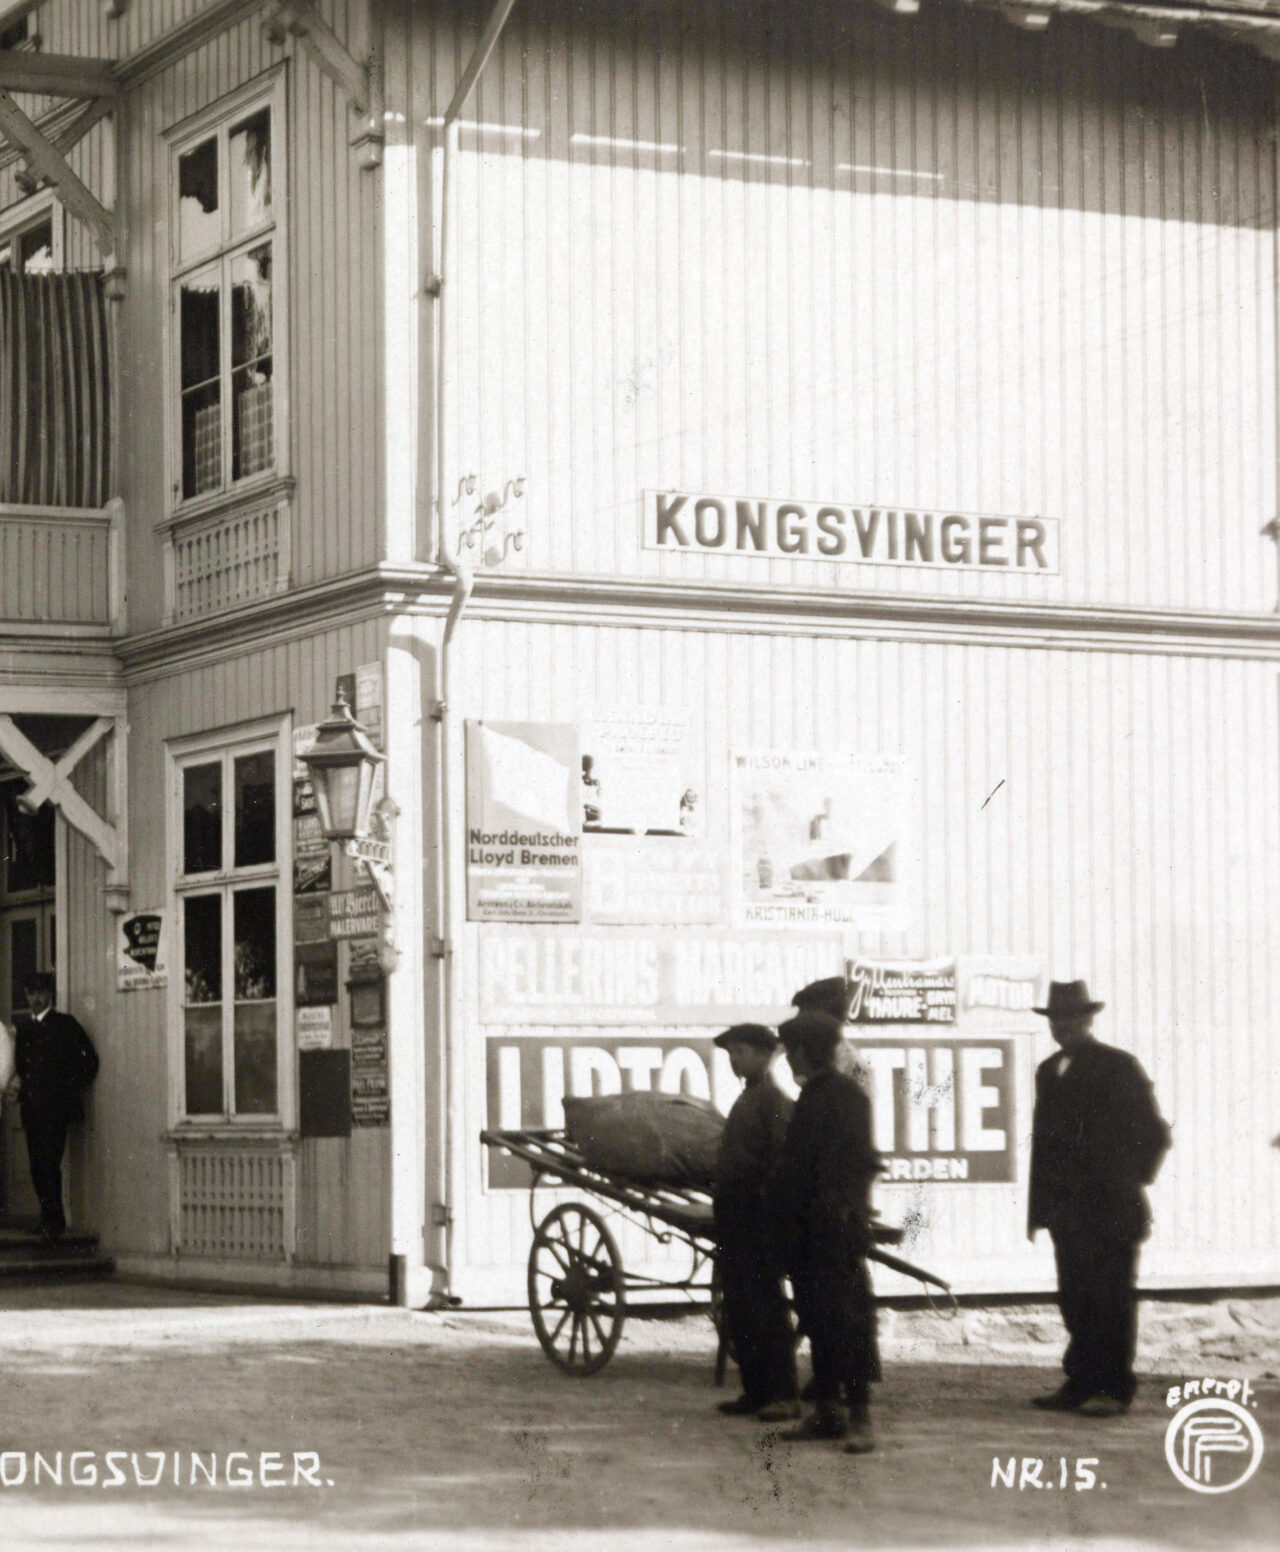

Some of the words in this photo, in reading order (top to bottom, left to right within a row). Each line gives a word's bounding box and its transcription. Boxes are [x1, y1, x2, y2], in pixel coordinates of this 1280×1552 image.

[655, 493, 1049, 569] KONGSVINGER
[736, 755, 789, 770] WILSON
[469, 829, 579, 847] Norddeutscher
[469, 848, 514, 868] Lloyd
[521, 849, 579, 866] Bremen
[858, 1047, 1007, 1152] THE
